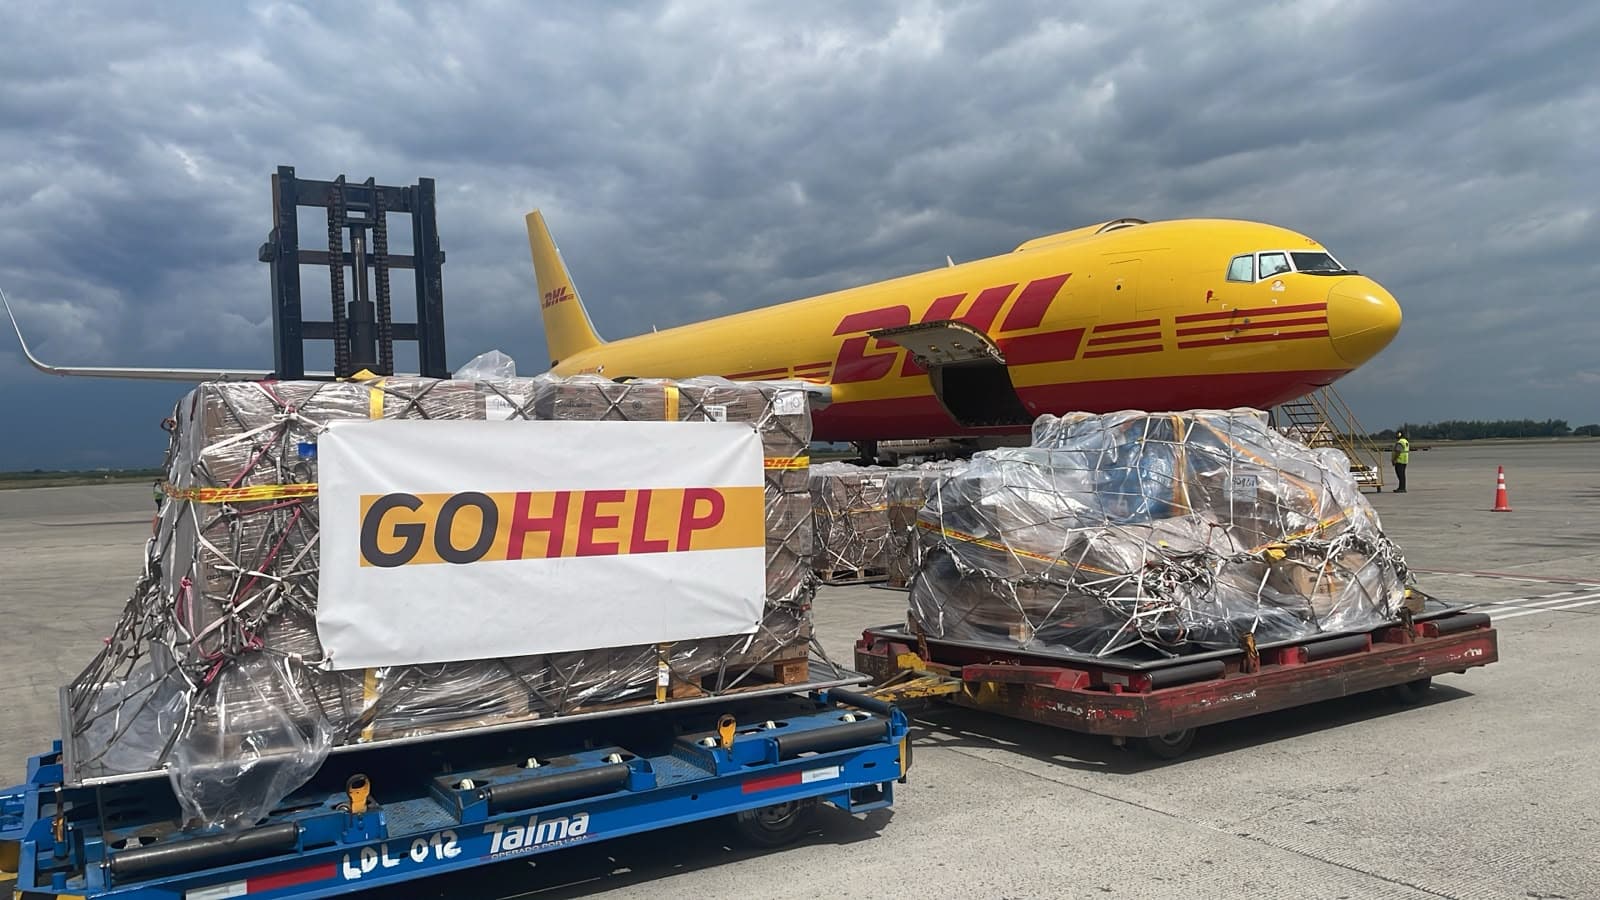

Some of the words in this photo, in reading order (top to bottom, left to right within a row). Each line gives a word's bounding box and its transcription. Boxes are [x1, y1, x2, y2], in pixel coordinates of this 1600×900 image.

[545, 286, 567, 308] DHL
[831, 273, 1086, 384] DHL
[360, 487, 726, 568] GOHELP
[342, 843, 400, 881] LDL
[411, 830, 462, 863] 012
[483, 812, 590, 855] Talma
[491, 845, 540, 859] OPERADO
[541, 840, 563, 849] POR
